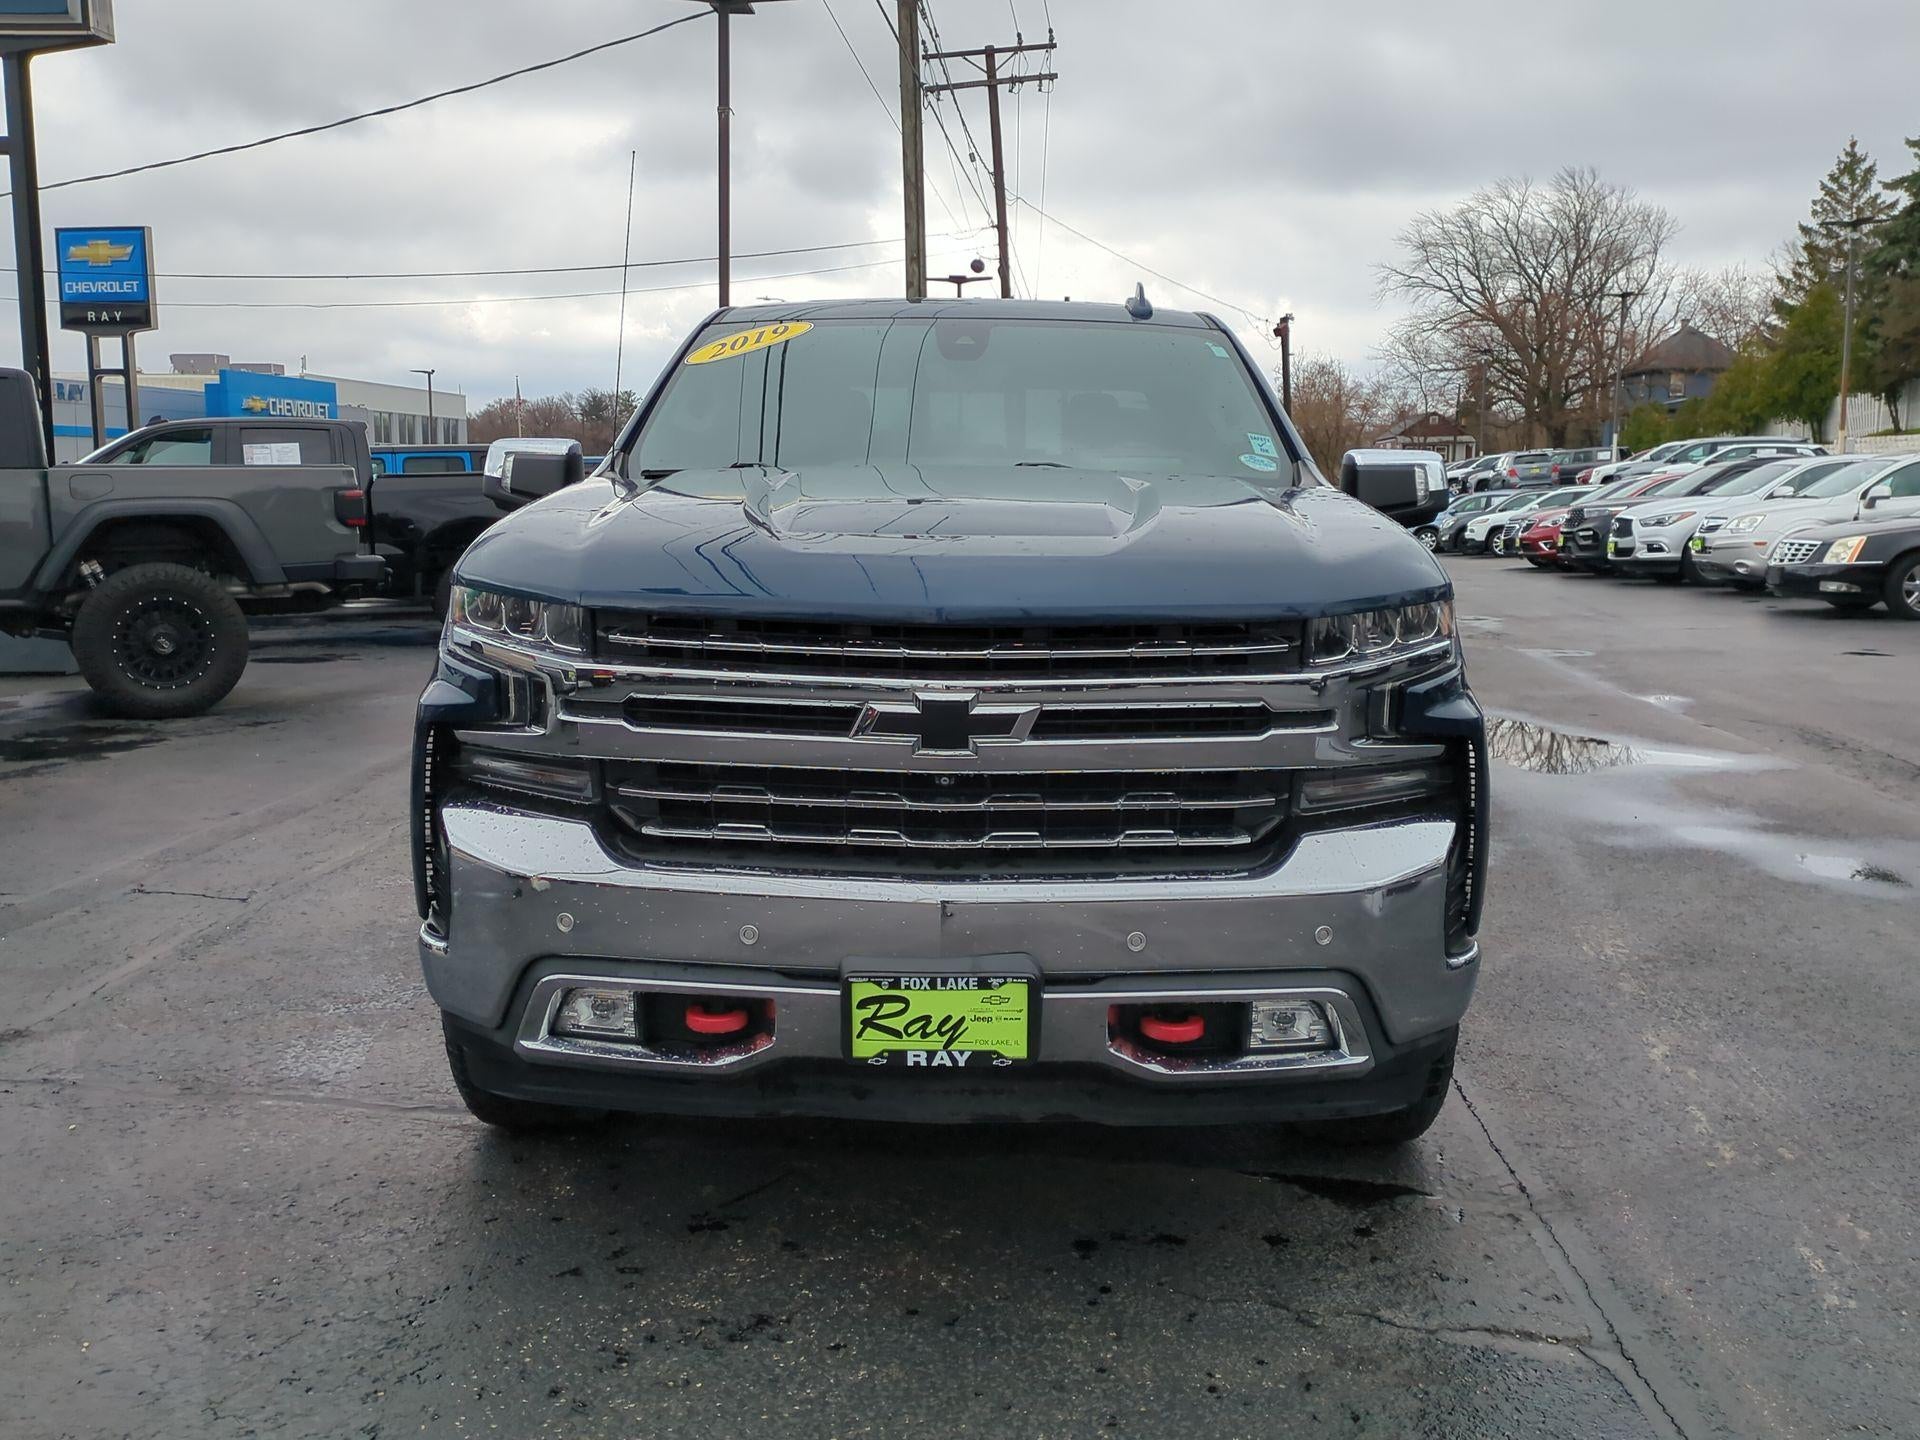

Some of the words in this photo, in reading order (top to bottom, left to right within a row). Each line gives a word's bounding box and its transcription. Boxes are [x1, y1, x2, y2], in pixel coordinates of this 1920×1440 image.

[65, 281, 139, 293] CHEVROLET
[87, 311, 122, 321] RAY
[709, 325, 789, 359] 2019
[269, 398, 330, 419] CHEVROLET
[900, 977, 930, 990] FOX
[937, 977, 978, 990] LAKE
[856, 994, 968, 1050] Ray
[970, 1014, 993, 1024] Jeep
[990, 1039, 1013, 1047] LAKE,
[907, 1050, 972, 1067] RAY
